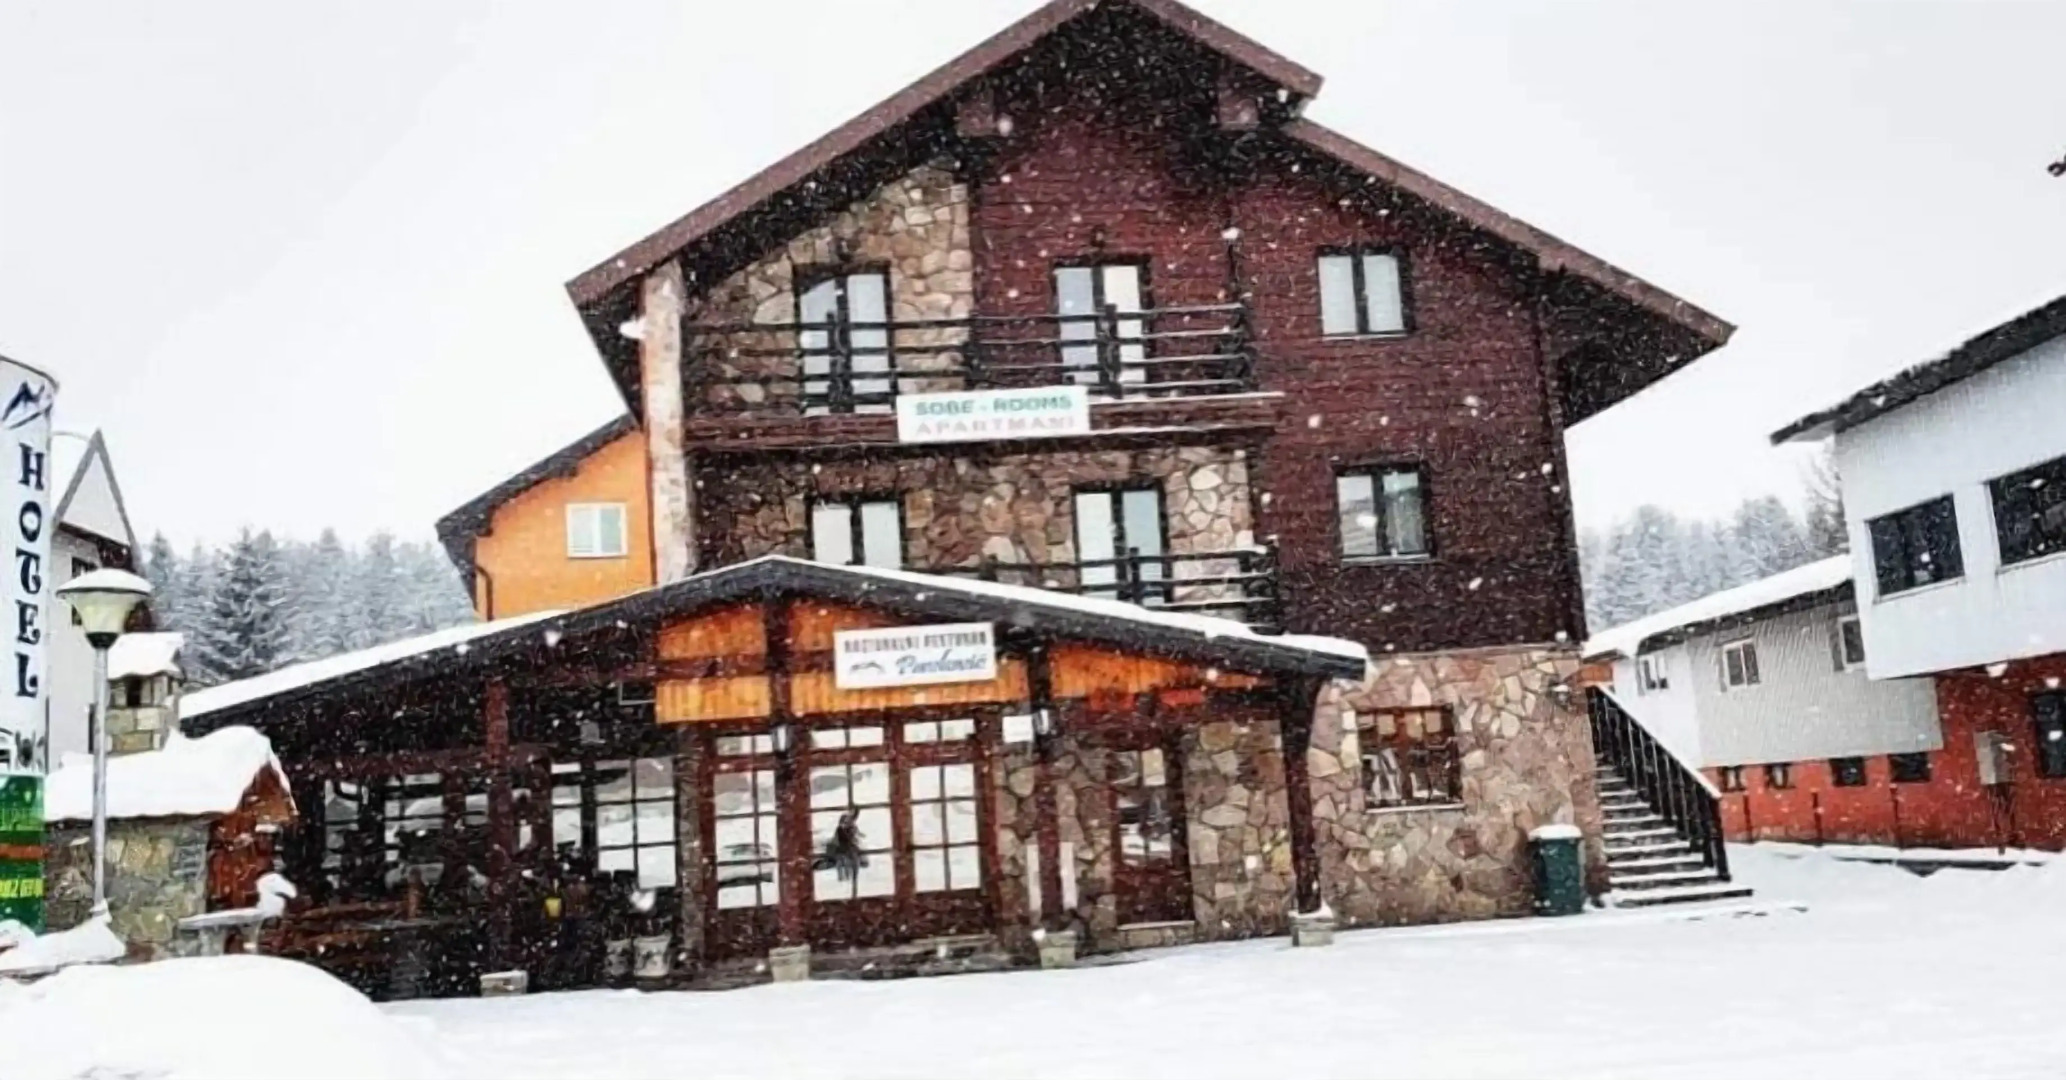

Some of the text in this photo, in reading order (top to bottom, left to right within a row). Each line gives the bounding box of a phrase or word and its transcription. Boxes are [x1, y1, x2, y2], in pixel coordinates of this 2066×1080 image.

[914, 399, 976, 416] SOBE
[992, 395, 1074, 413] ROOMS
[915, 416, 1075, 436] APARTMANI
[15, 441, 45, 699] HOTEL
